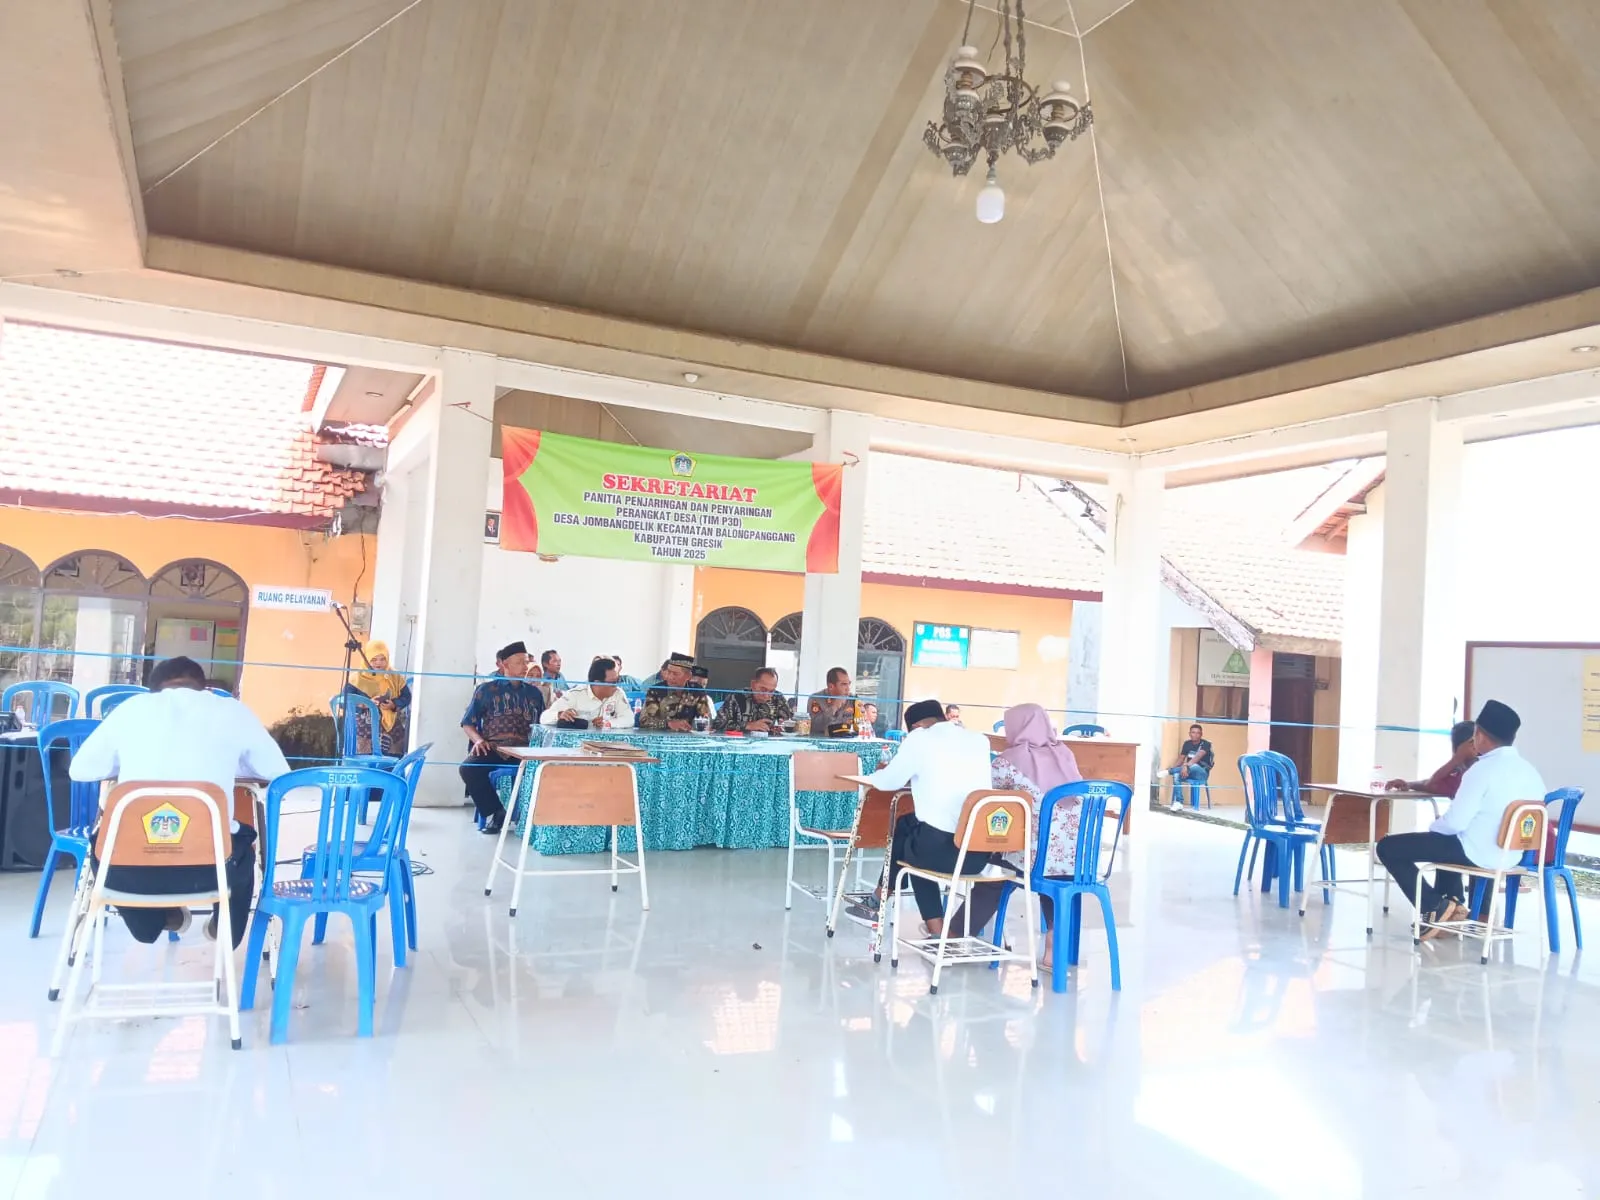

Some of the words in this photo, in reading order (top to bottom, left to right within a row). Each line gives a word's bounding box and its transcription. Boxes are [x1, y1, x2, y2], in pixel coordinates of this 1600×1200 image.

[603, 474, 756, 502] SEKRETARIAT
[583, 492, 622, 505] PANITIA
[624, 496, 688, 511] PENJARINGAN
[690, 502, 708, 513] DAN
[711, 505, 772, 518] PENYARINGAN
[553, 513, 580, 525] DESA
[582, 517, 654, 532] JOMBANGDELIK
[656, 523, 713, 537] KECAMATAN
[715, 528, 796, 543] BALONGPANGGANG
[616, 507, 671, 521] PERANGKAT
[674, 513, 697, 523] DESA
[699, 515, 719, 526] (TIM
[722, 517, 742, 528] P3D)
[634, 533, 689, 547] KABUPATEN
[691, 538, 723, 549] GRESIK
[651, 546, 681, 558] TAHUN
[683, 549, 706, 560] 2025
[258, 592, 283, 602] RUANG
[285, 594, 326, 605] PELAYANAN
